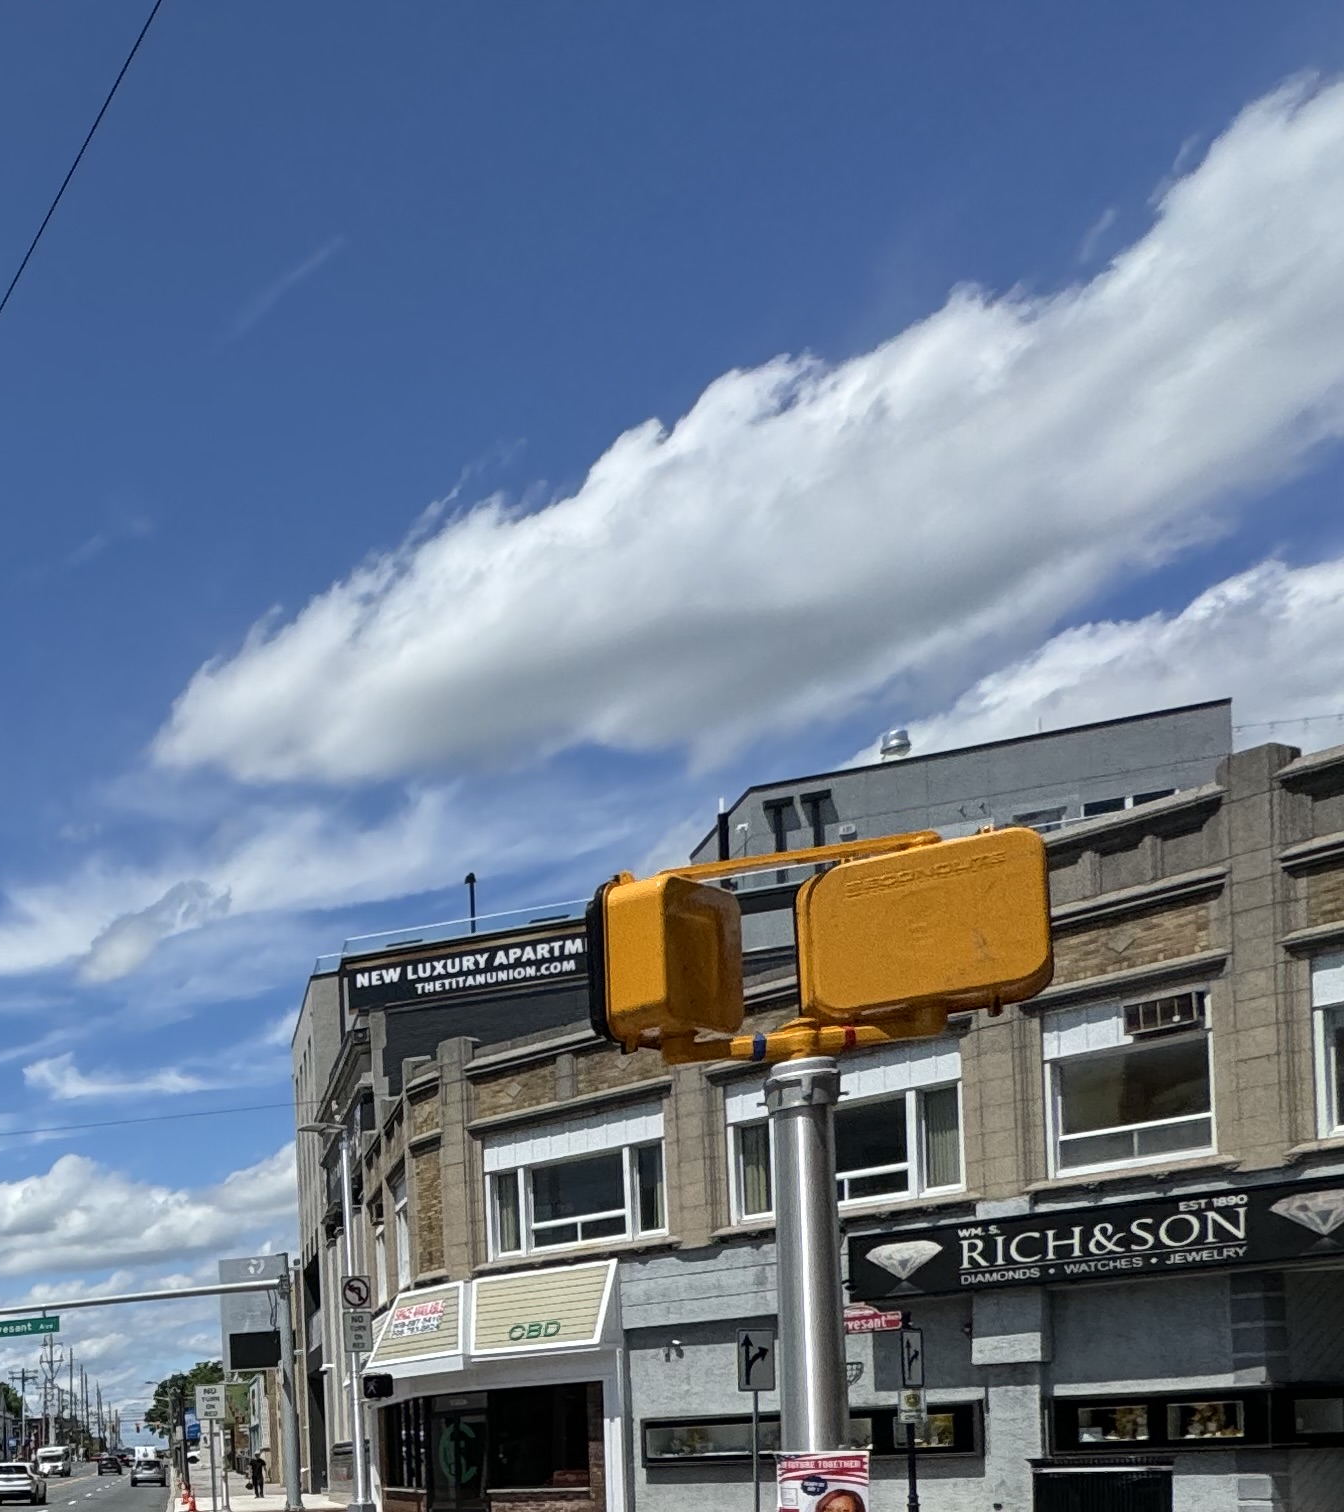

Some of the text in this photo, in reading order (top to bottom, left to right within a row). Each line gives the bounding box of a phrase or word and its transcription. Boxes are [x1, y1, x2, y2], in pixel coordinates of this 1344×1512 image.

[356, 937, 588, 989] NEW LUXURY APARTM
[415, 959, 576, 995] THETITANUNION.COM
[1178, 1194, 1248, 1212] EST 1890
[957, 1227, 984, 1238] WM.
[959, 1207, 1248, 1270] RICH&SON
[961, 1246, 1247, 1285] DIAMONDS WATCHES JEWELRY
[351, 1315, 363, 1323] NO
[509, 1320, 561, 1341] CBD
[203, 1387, 217, 1395] NO
